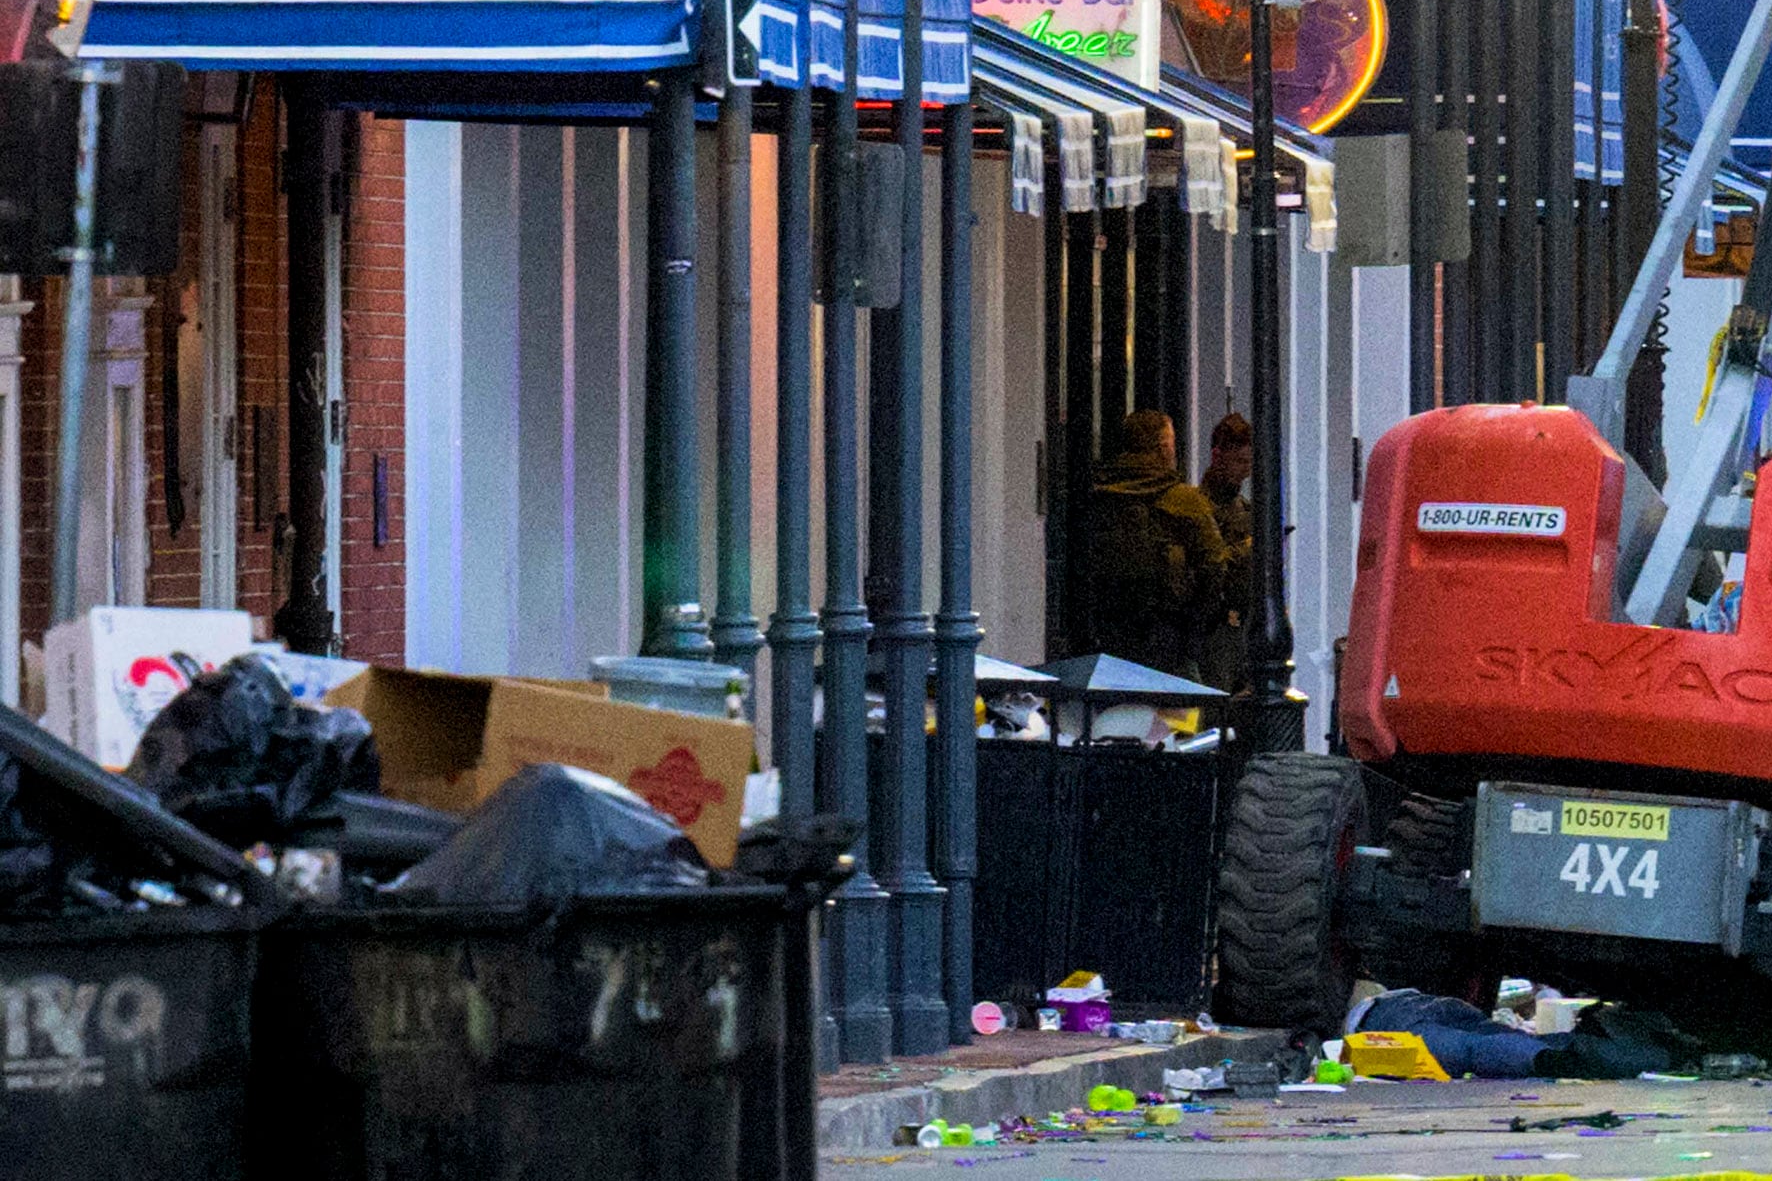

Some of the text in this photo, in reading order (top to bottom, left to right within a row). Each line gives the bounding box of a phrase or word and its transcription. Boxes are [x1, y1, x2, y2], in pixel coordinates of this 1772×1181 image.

[1422, 509, 1559, 529] 1-800-UR-RENTS
[1563, 807, 1668, 832] 10507501
[1559, 842, 1661, 899] 4X4
